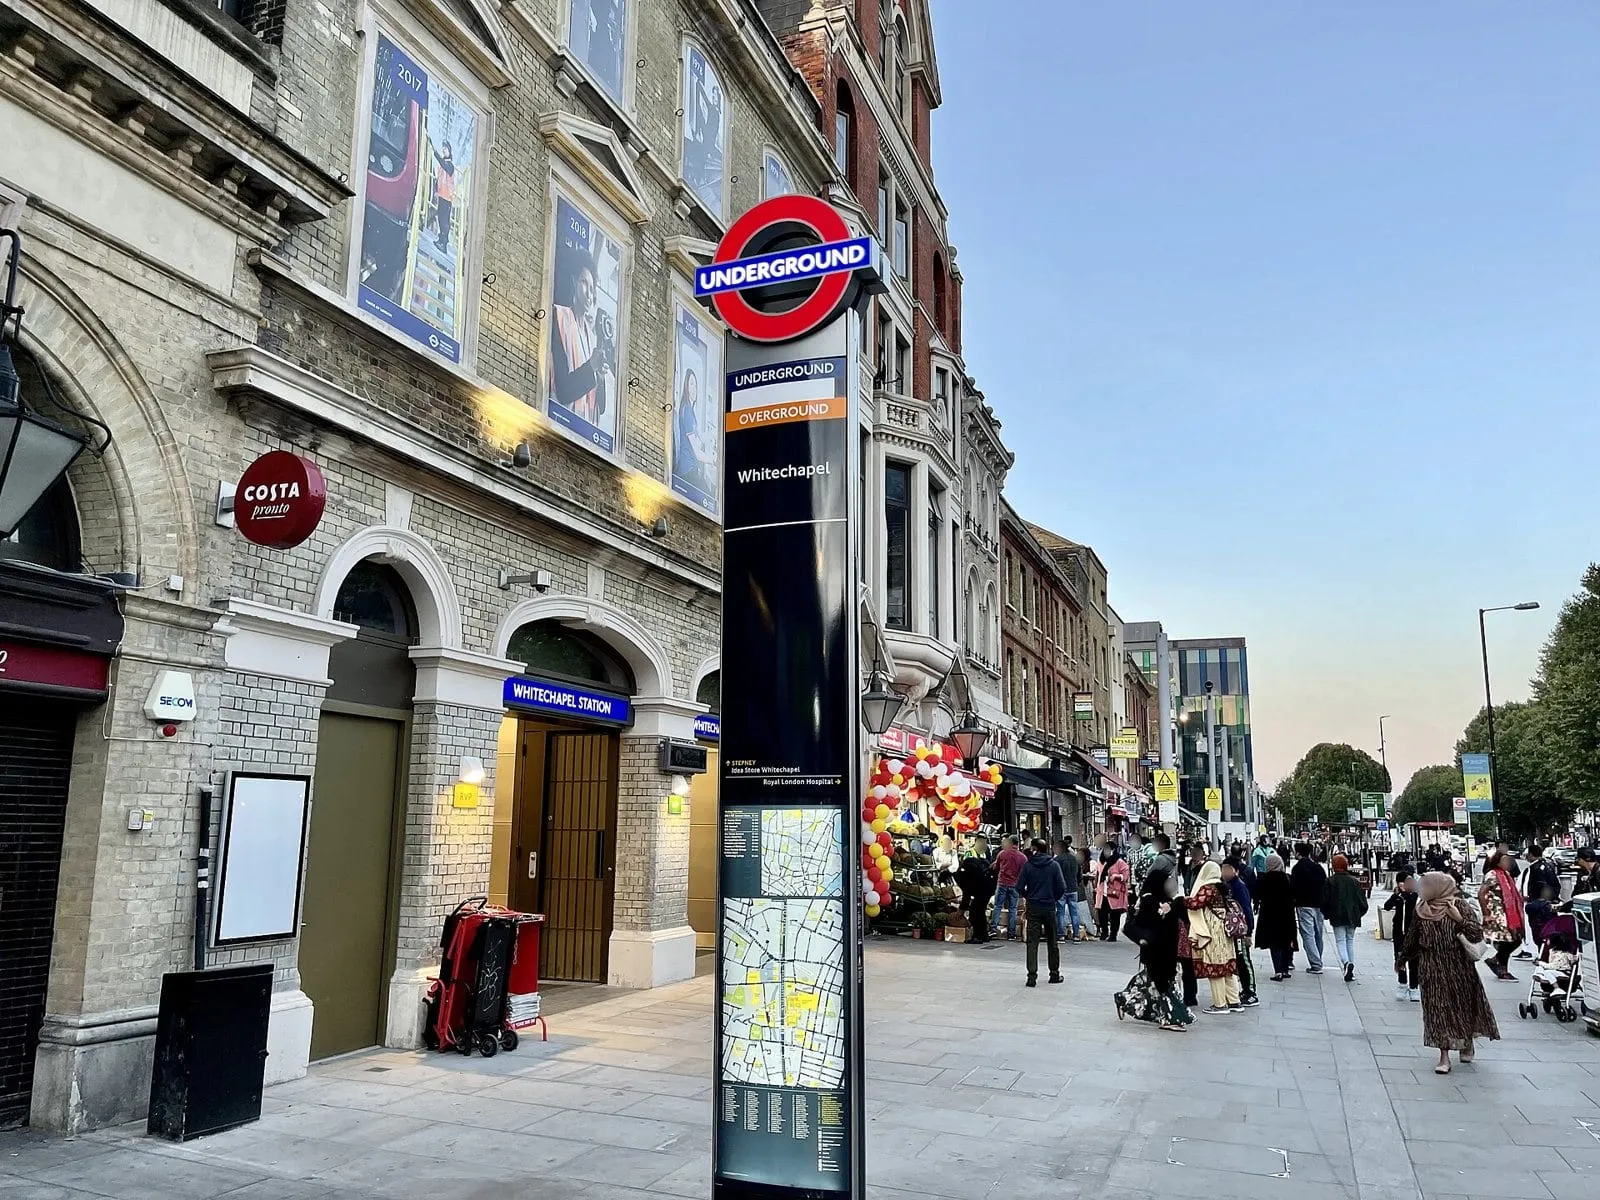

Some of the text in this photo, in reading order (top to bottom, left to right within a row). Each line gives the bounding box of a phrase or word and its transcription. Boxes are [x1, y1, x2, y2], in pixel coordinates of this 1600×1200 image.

[398, 64, 422, 92] 2017
[570, 217, 587, 239] 2018
[701, 245, 865, 290] UNDERGROUND
[735, 363, 834, 387] UNDERGROUND
[739, 403, 829, 425] OVERGROUND
[738, 461, 831, 484] Whitechapel
[244, 482, 300, 501] COSTA
[251, 502, 290, 520] pronto
[159, 696, 193, 708] SECOM
[513, 683, 611, 715] WHITECHAPEL STATION
[762, 766, 801, 774] Whitechapel
[763, 778, 834, 787] Royal London Hospital
